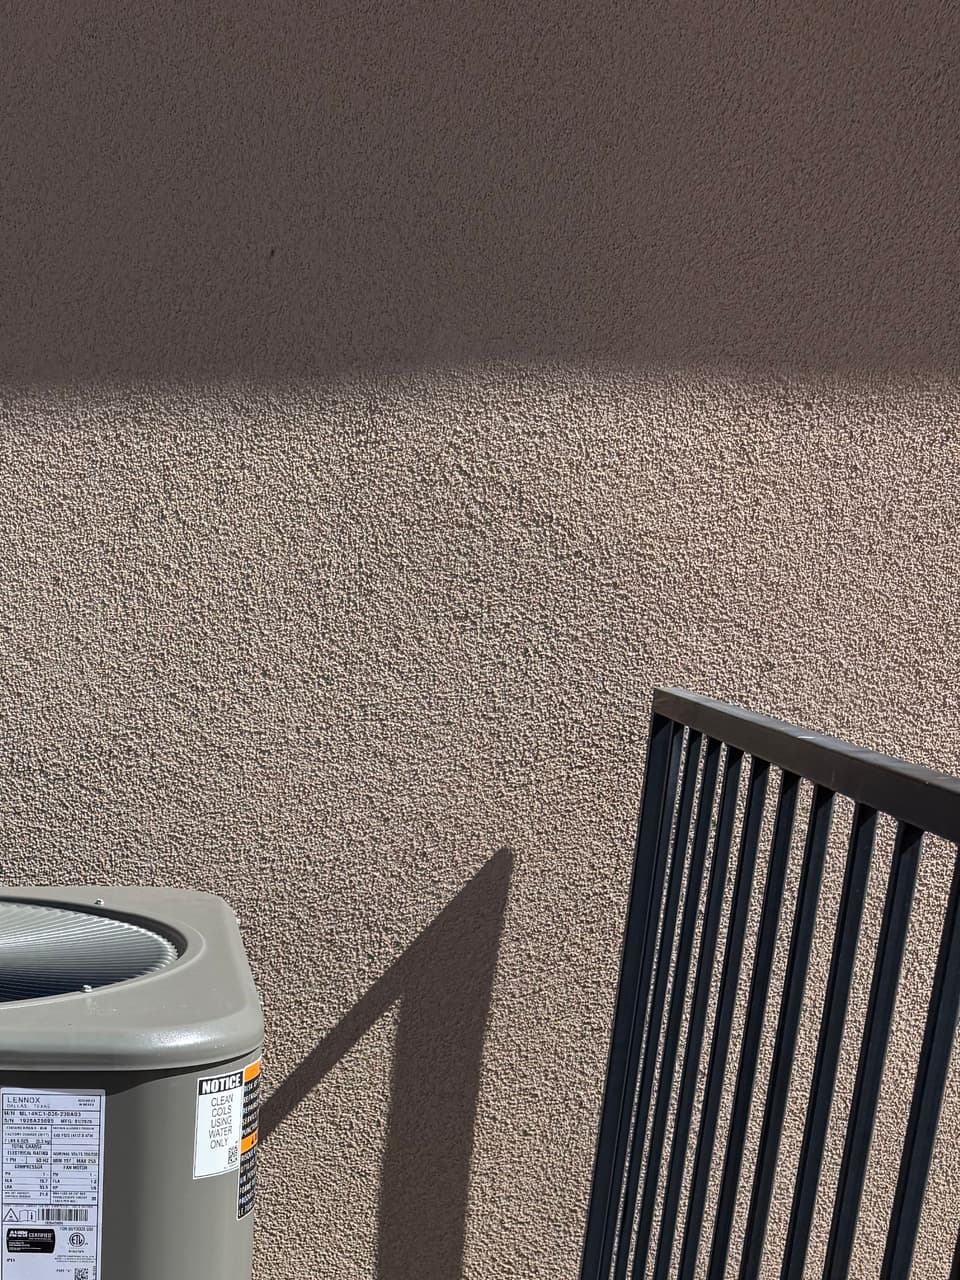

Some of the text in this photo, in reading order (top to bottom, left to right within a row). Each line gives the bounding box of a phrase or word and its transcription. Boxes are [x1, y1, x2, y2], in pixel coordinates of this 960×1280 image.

[202, 1074, 241, 1094] NOTICE
[211, 1093, 233, 1107] CLEAN
[211, 1116, 232, 1128] USING
[208, 1126, 233, 1138] WATER
[210, 1137, 228, 1149] ONLY
